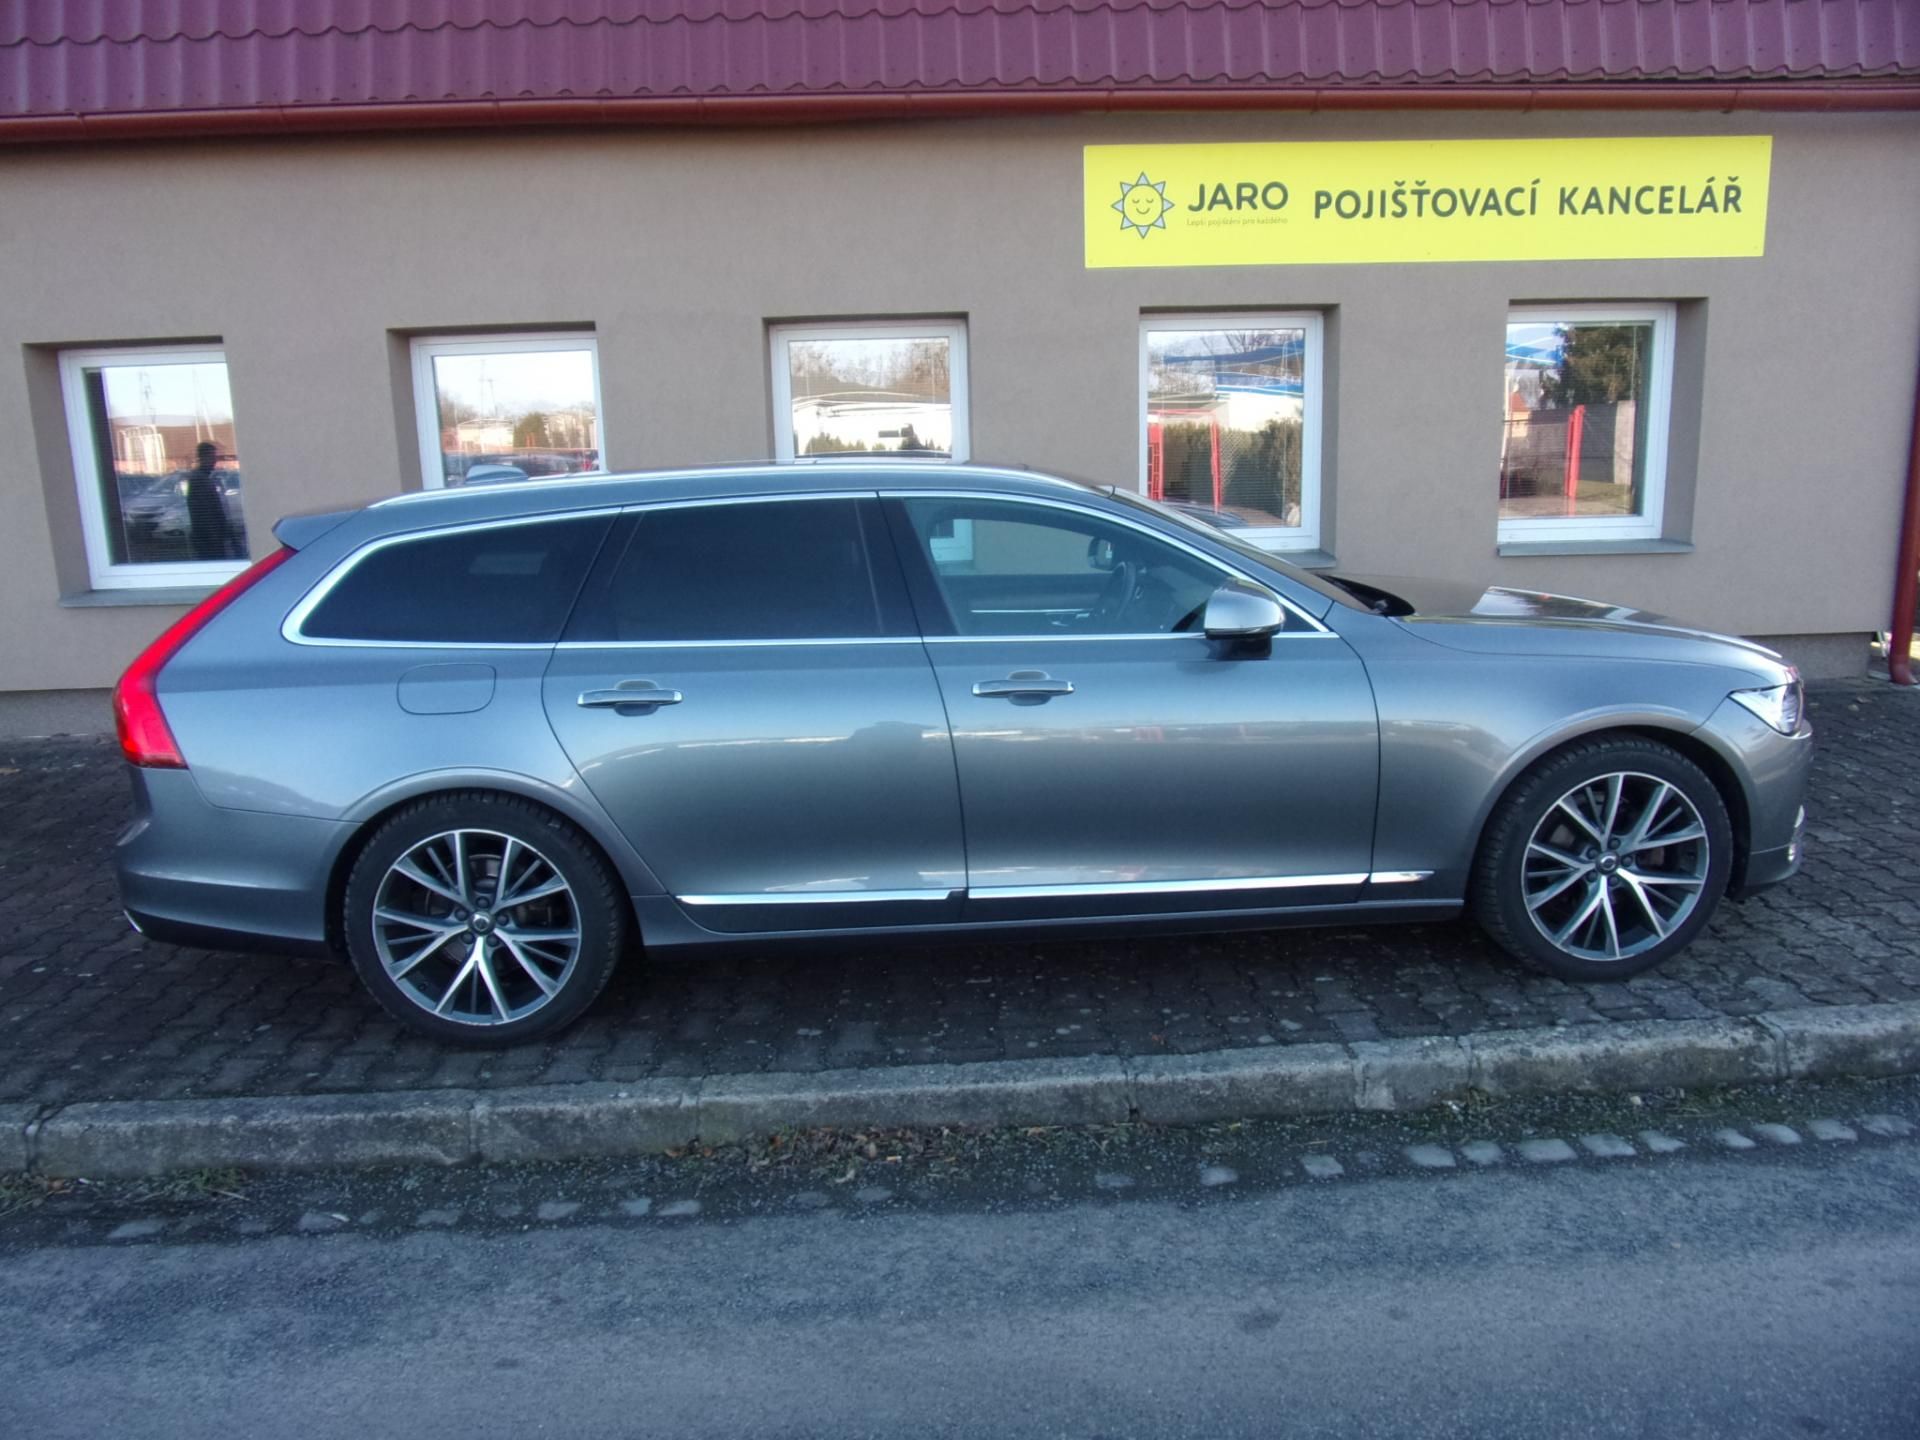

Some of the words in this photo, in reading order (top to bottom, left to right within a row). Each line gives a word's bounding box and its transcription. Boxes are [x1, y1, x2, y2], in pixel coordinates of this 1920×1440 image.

[1188, 181, 1289, 212] JARO
[1314, 178, 1540, 219] POJIŠŤOVACÍ
[1559, 176, 1742, 215] KANCELÁŘ
